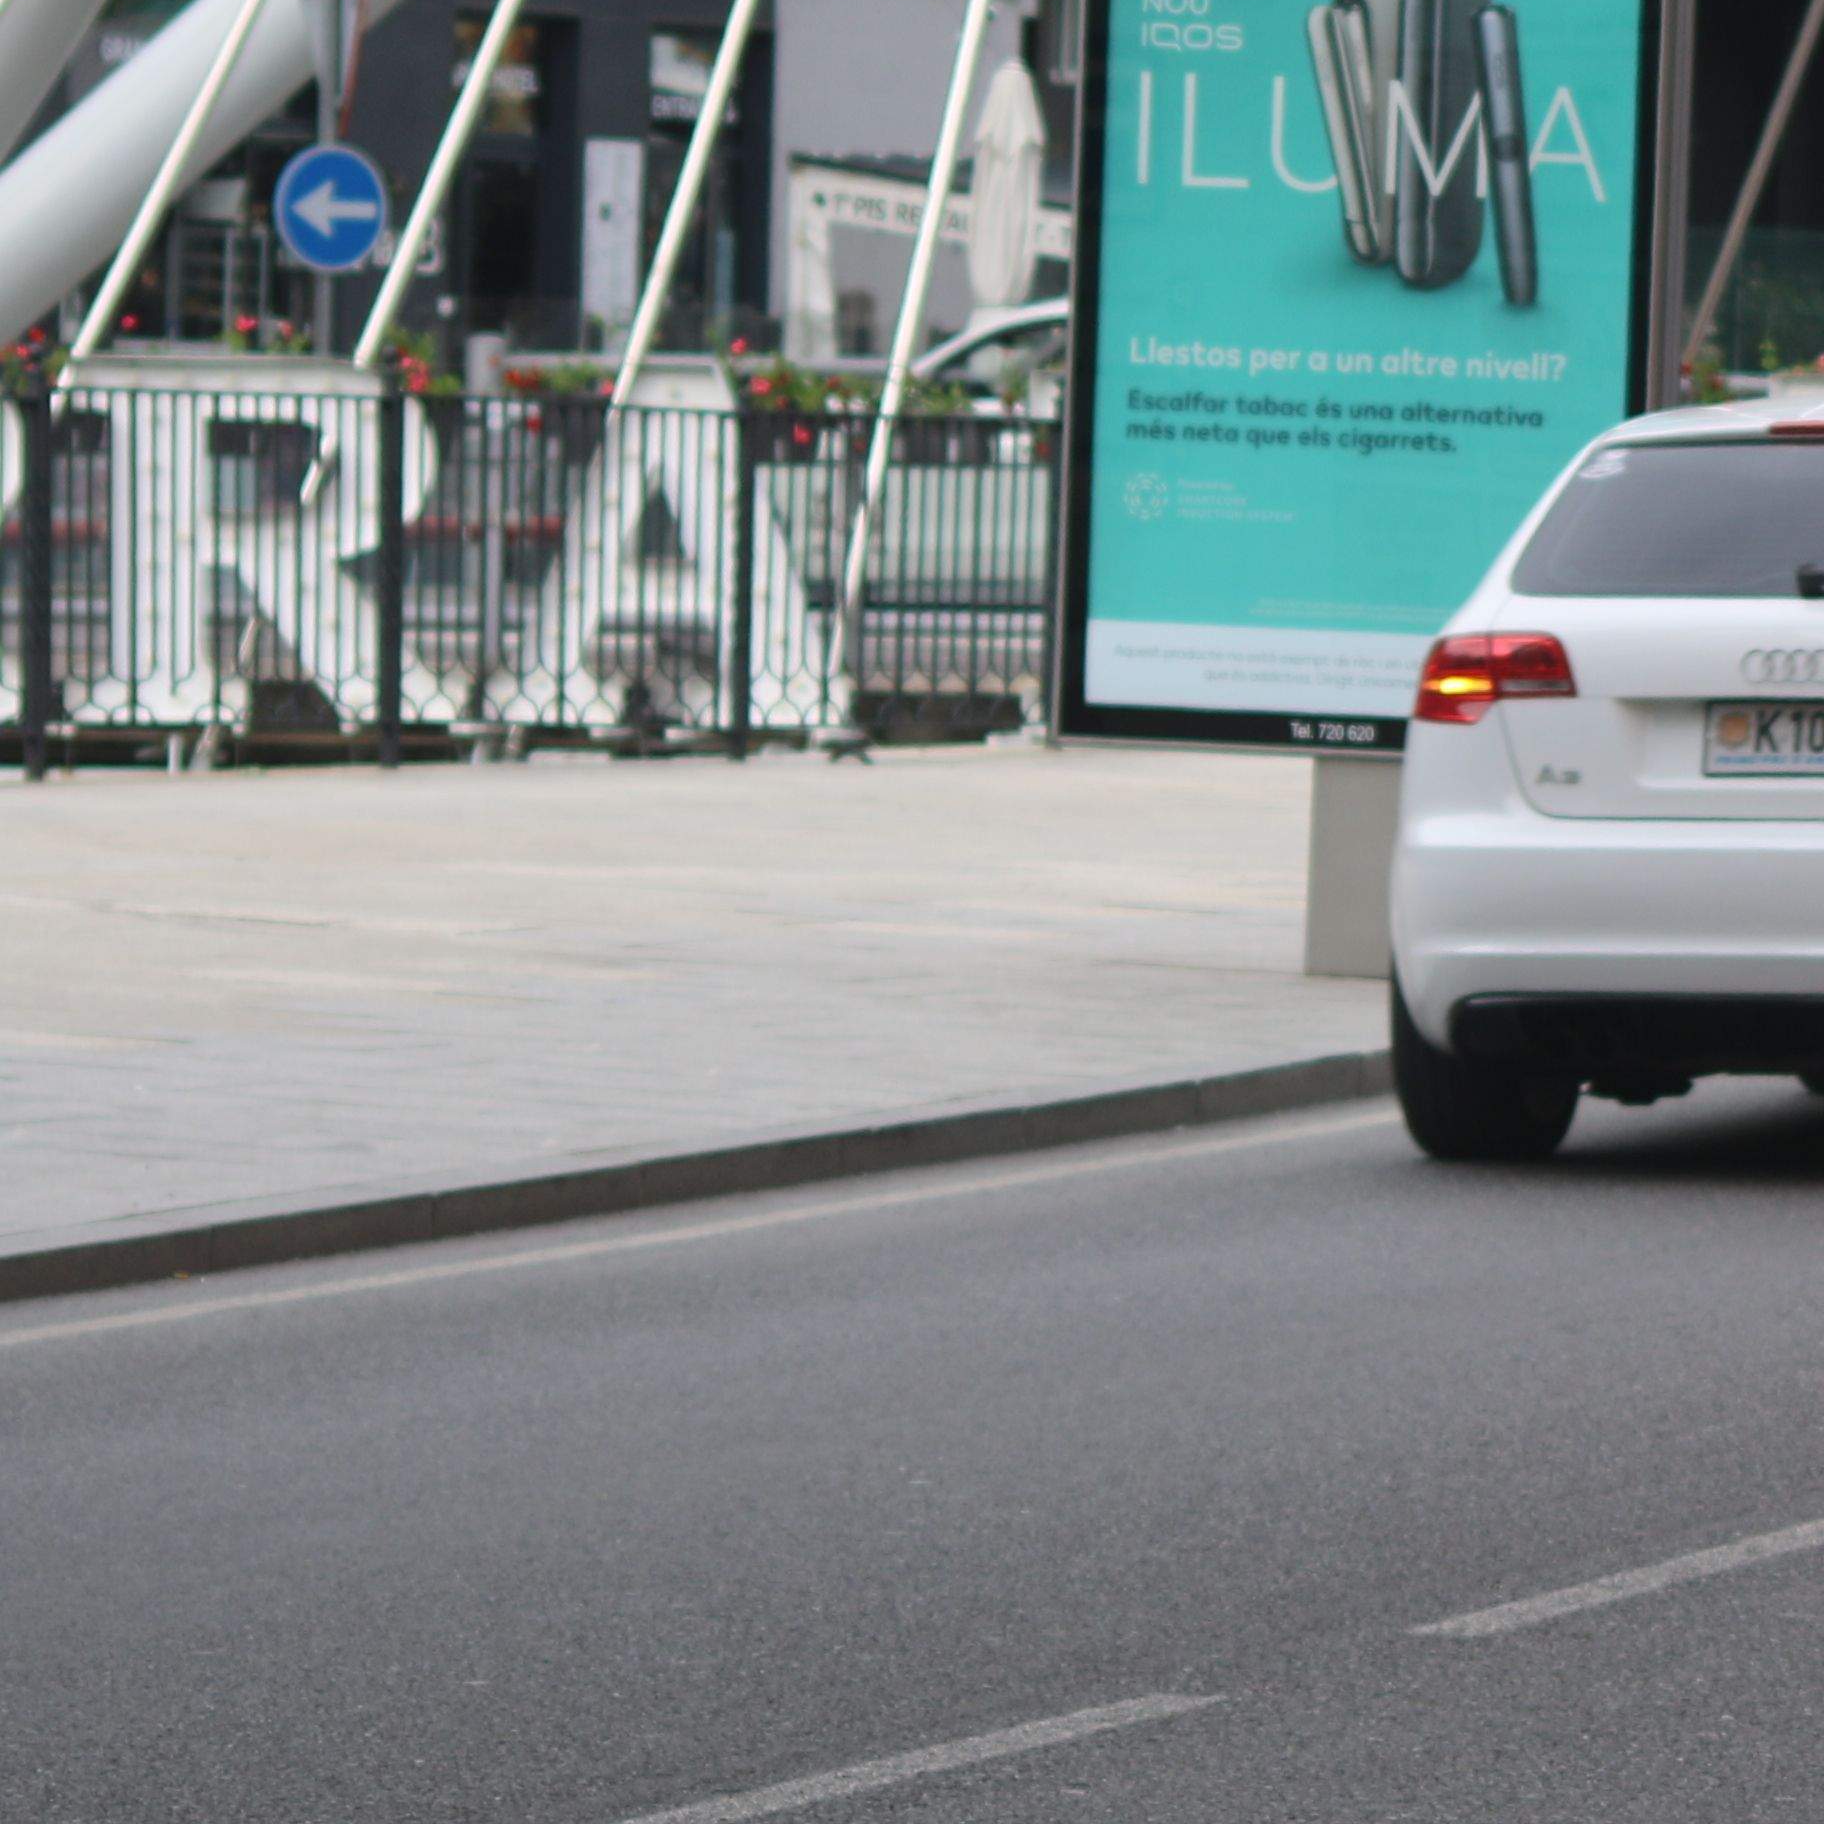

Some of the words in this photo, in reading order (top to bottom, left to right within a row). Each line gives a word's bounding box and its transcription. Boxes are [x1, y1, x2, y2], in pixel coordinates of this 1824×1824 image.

[1140, 22, 1245, 52] IQOS
[1137, 70, 1606, 204] ILUMA
[1130, 335, 1242, 368] Llestos
[1249, 348, 1301, 377] per
[1308, 350, 1329, 372] a
[1336, 351, 1373, 374] un
[1381, 347, 1457, 376] altre
[1466, 352, 1568, 381] nivell?
[1128, 388, 1227, 415] Escalfar
[1235, 394, 1308, 417] tabac
[1315, 395, 1342, 419] és
[1350, 403, 1393, 422] una
[1401, 401, 1544, 428] alternativa
[1126, 419, 1176, 441] més
[1182, 422, 1240, 443] neta
[1246, 427, 1291, 450] que
[1298, 426, 1332, 448] els
[1337, 428, 1457, 456] cigarrets.
[1290, 722, 1314, 740] Tel.
[1318, 723, 1345, 742] 720
[1347, 725, 1376, 743] 620
[1754, 708, 1782, 754] K
